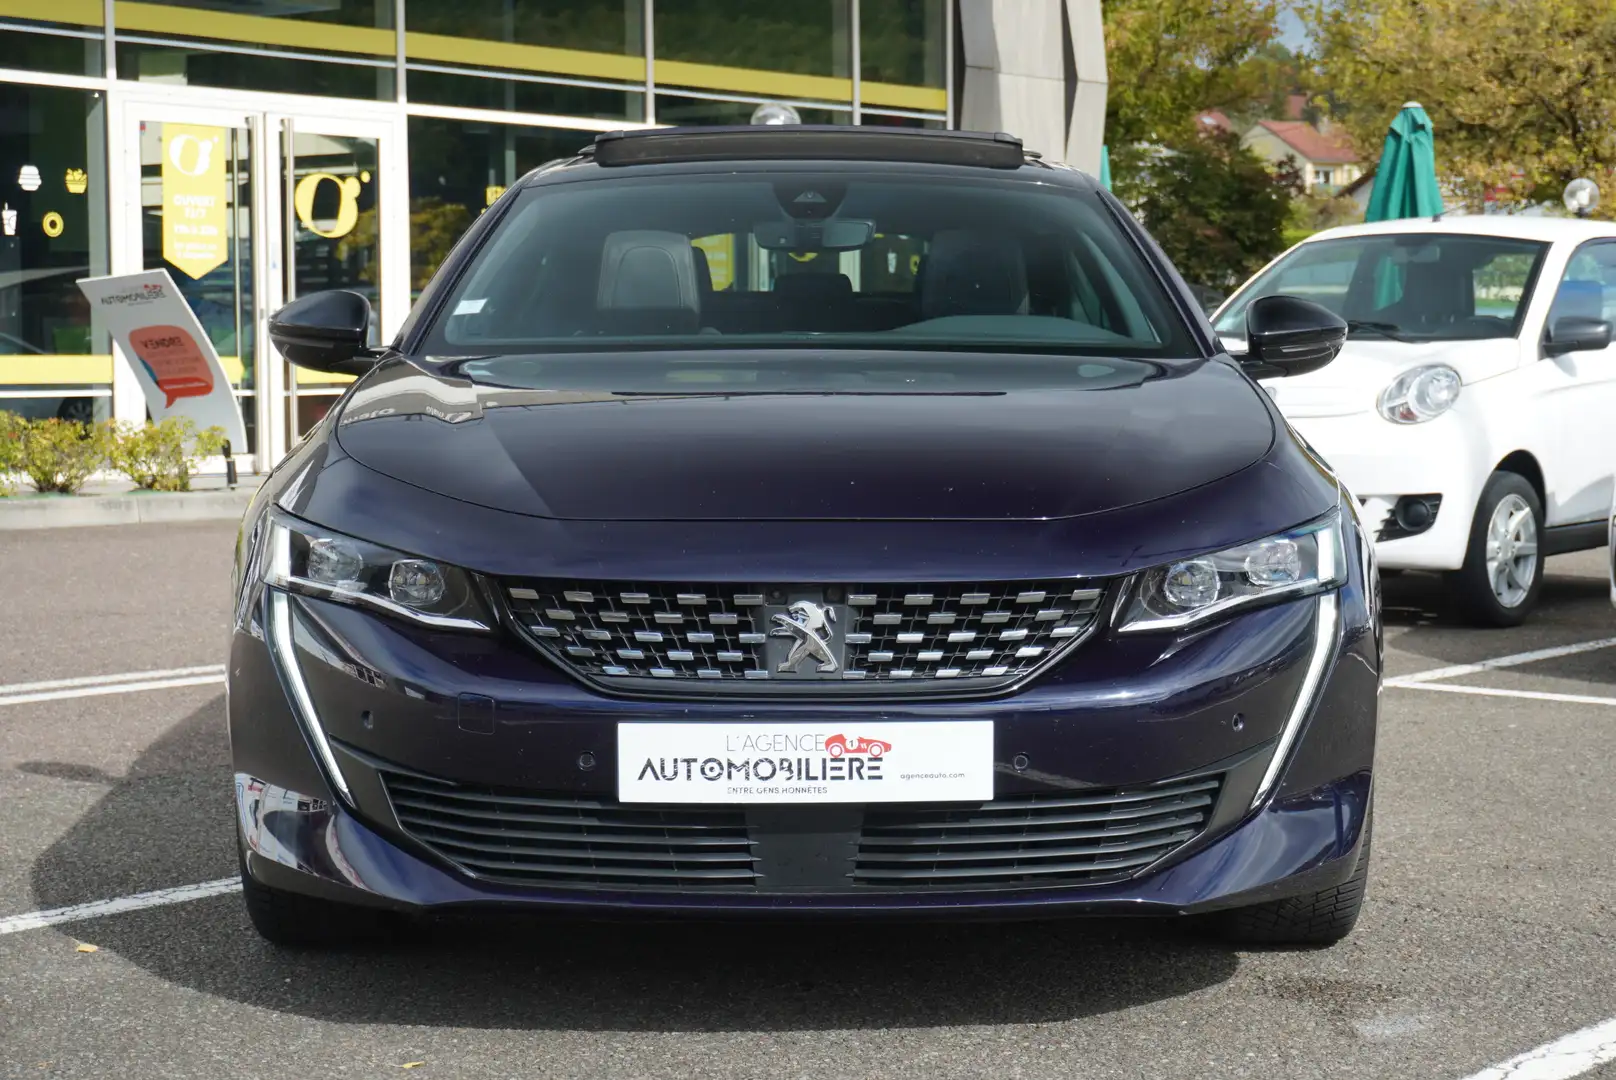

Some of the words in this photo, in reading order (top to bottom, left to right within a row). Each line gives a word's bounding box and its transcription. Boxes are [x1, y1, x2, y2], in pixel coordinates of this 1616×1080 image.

[726, 734, 825, 752] L'AGENCE
[900, 772, 965, 780] agenceauto.com
[727, 787, 753, 795] ENTRE
[756, 787, 779, 795] GENS
